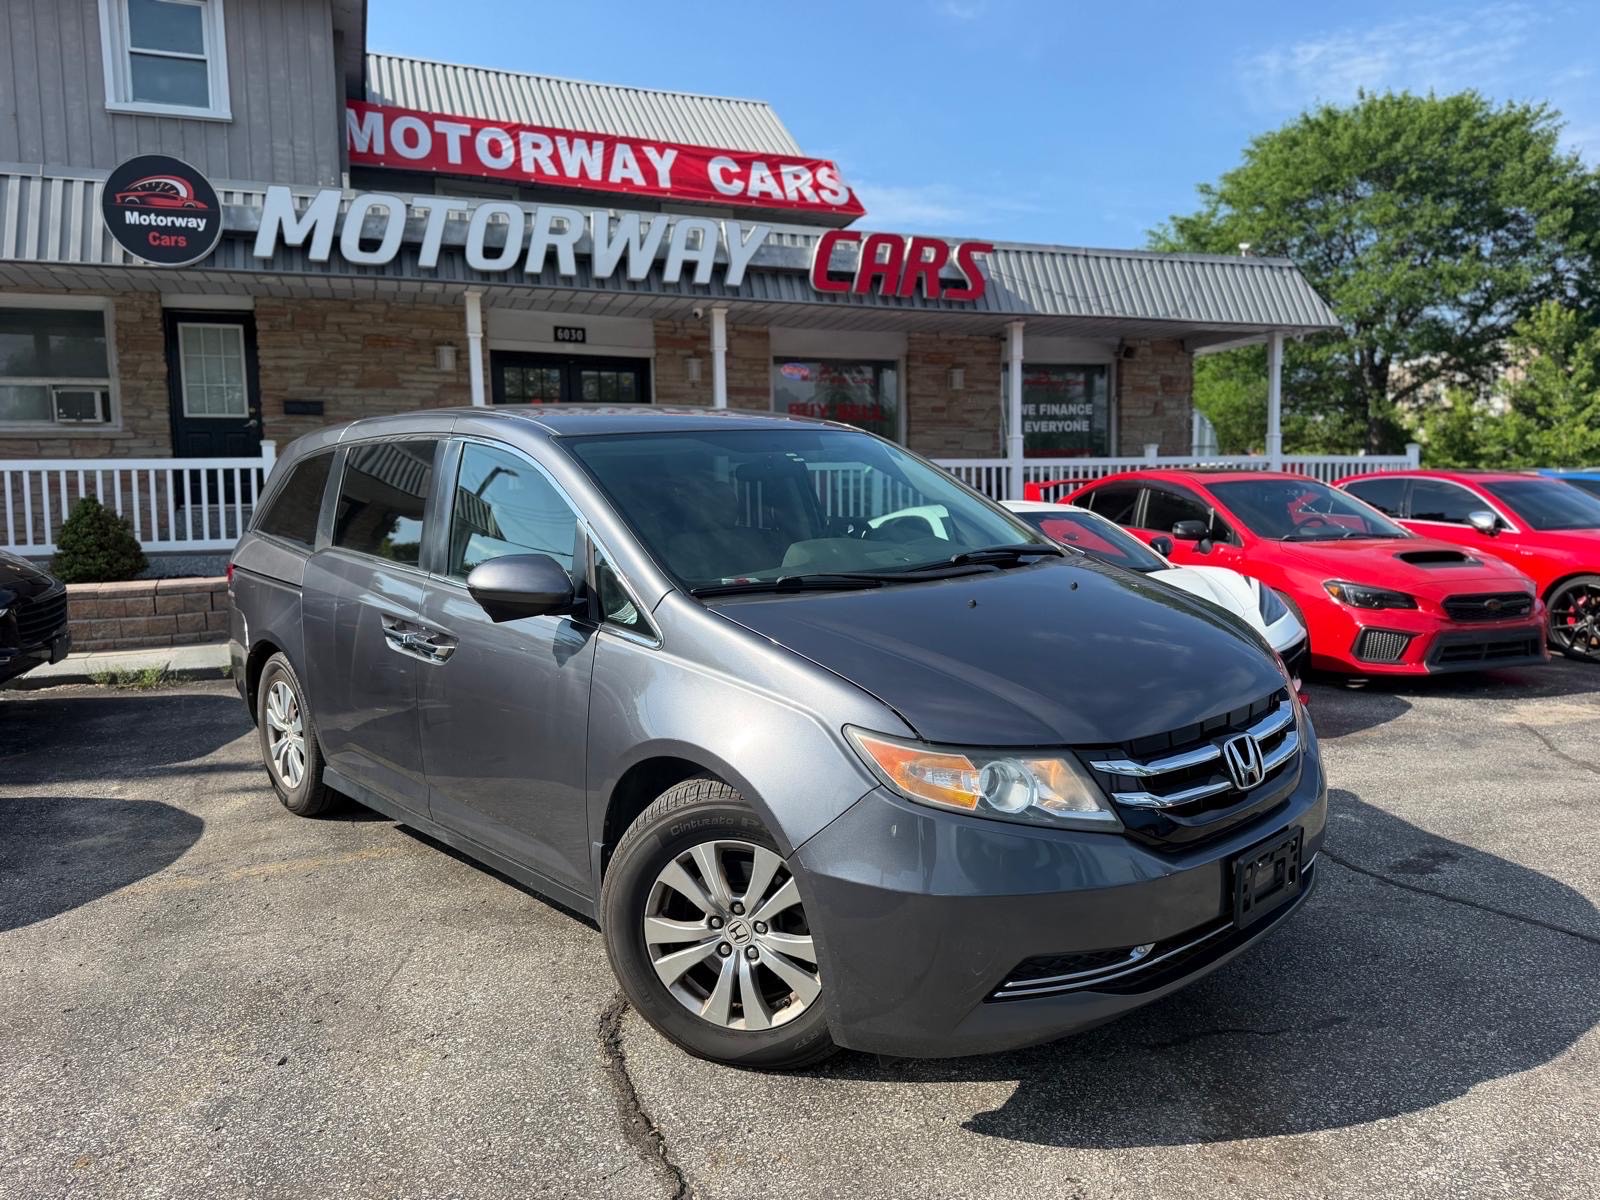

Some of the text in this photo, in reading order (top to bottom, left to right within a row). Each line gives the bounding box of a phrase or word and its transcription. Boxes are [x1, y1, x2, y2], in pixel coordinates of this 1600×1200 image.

[346, 108, 850, 206] MOTORWAY CARS
[125, 210, 207, 233] Motorway
[148, 231, 187, 248] Cars
[253, 185, 994, 301] MOTORWAY CARS
[556, 328, 584, 342] 6030
[1039, 403, 1094, 416] FINANCE
[1024, 420, 1091, 433] EVERYONE
